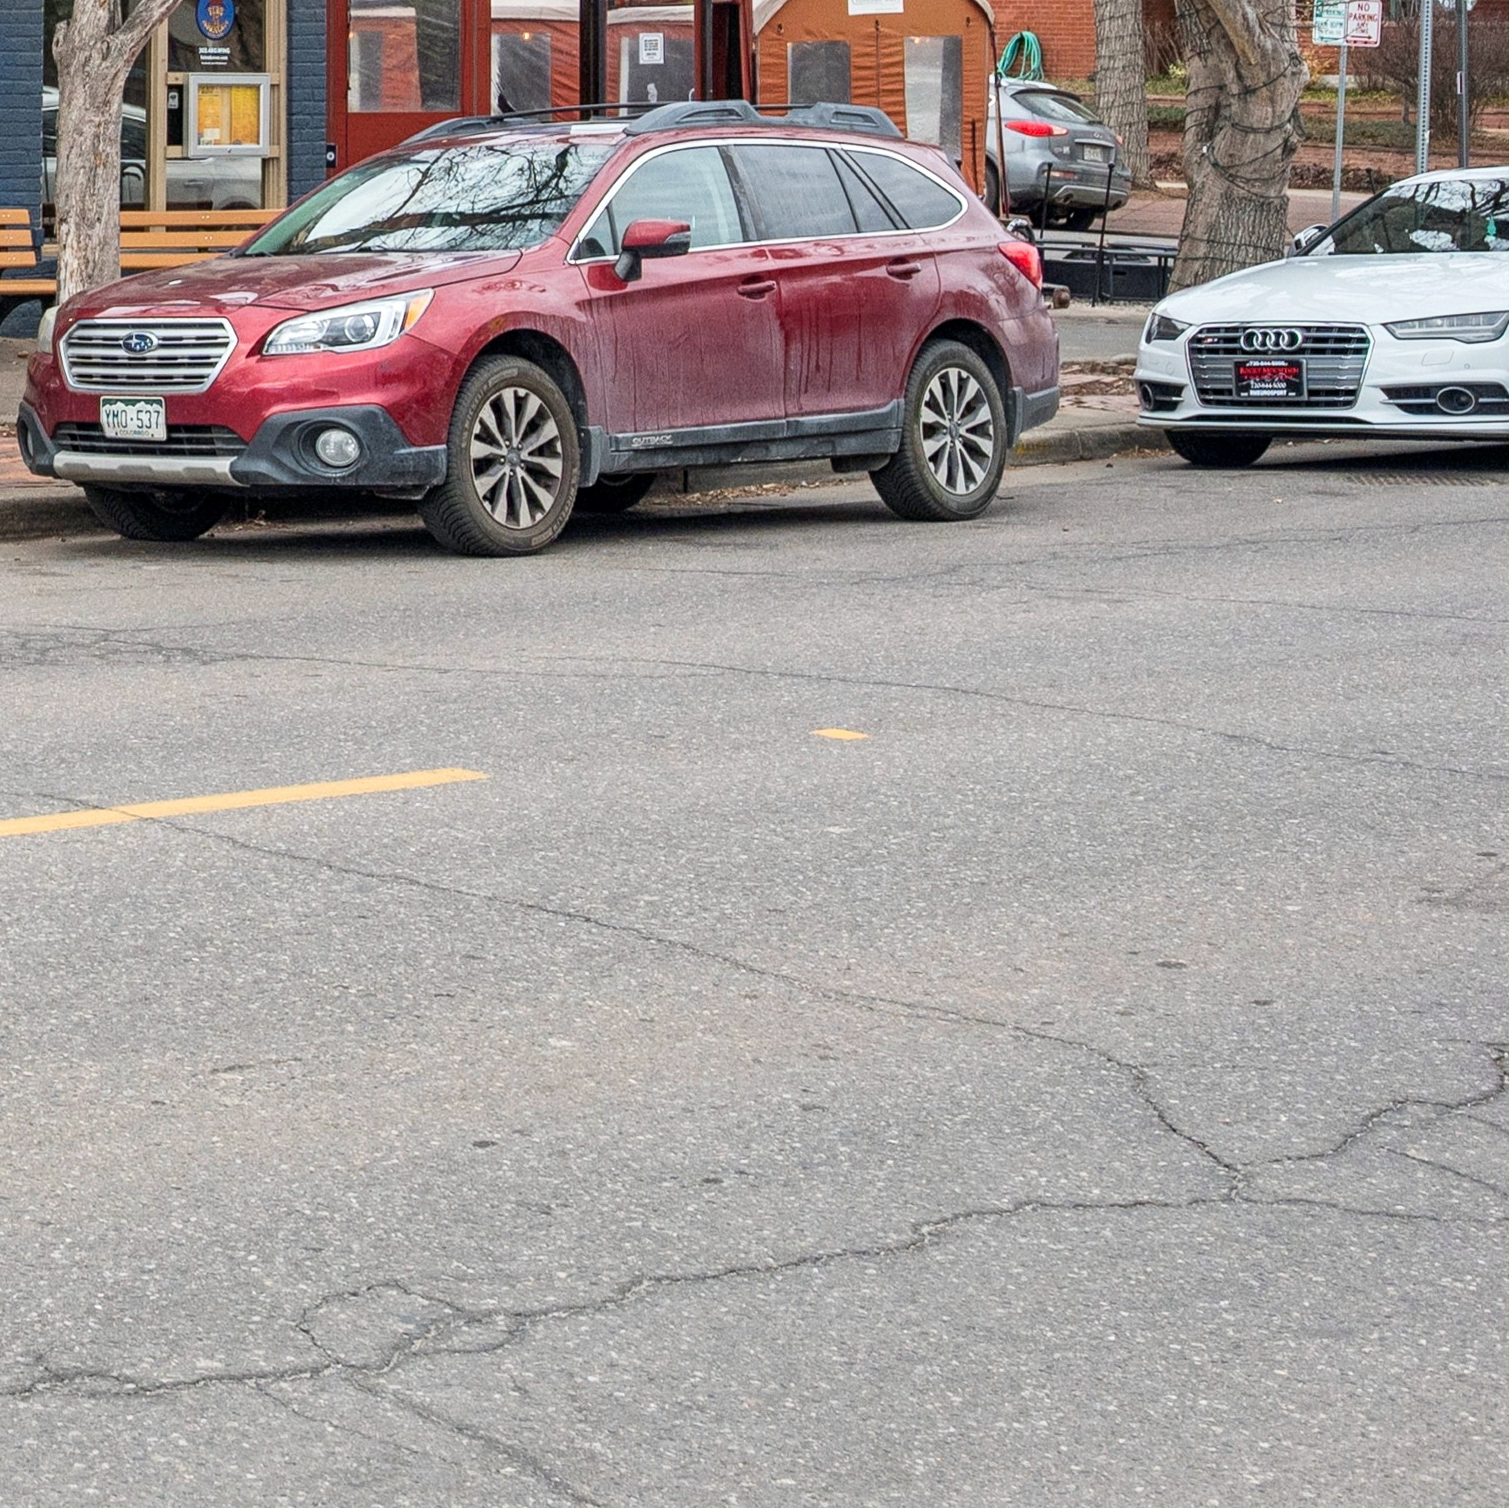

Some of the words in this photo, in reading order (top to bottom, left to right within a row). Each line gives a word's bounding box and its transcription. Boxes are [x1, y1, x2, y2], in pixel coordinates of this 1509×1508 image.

[1357, 2, 1371, 12] NO
[1349, 13, 1378, 22] PARKING
[631, 435, 673, 447] OUTBACK
